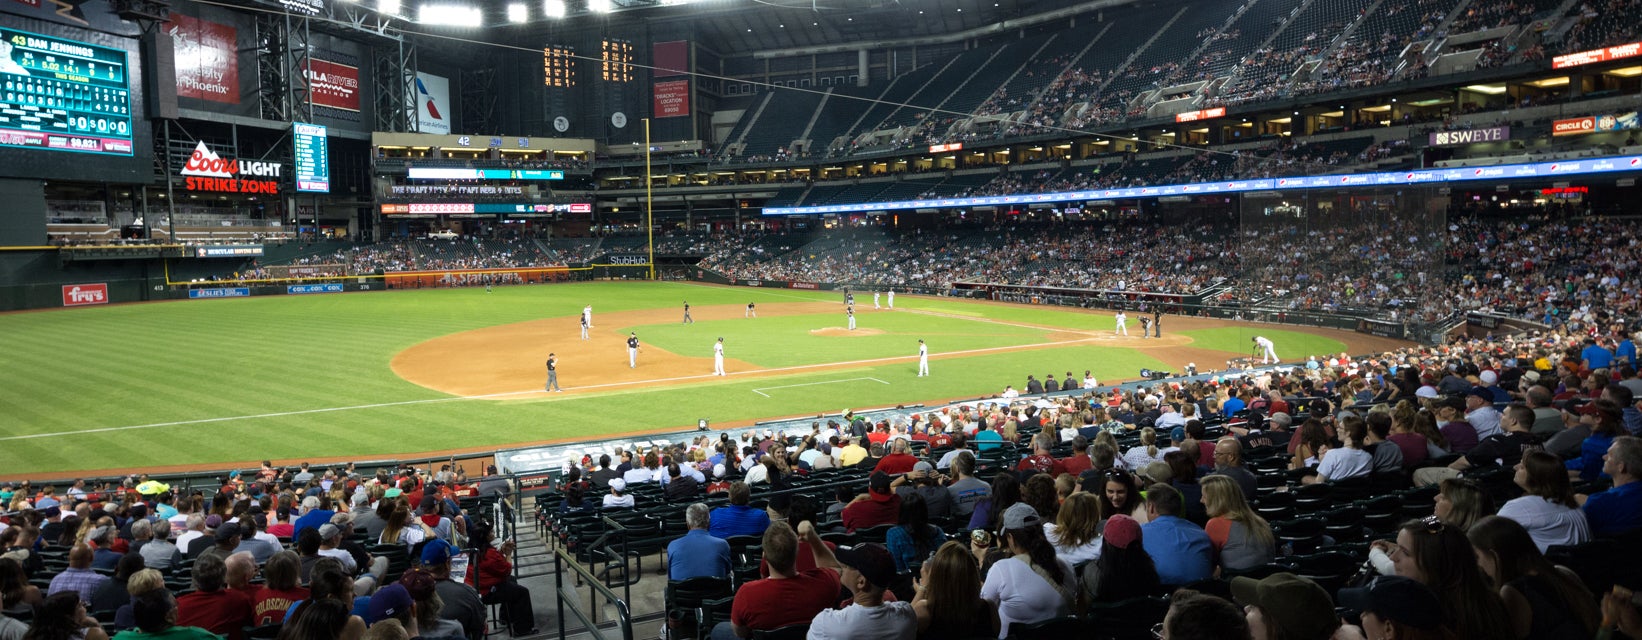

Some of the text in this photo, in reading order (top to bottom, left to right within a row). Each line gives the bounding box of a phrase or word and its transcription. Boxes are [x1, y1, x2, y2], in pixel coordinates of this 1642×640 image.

[12, 35, 94, 58] 43 DAN JENNINGS
[22, 58, 35, 67] 2-1
[64, 64, 79, 74] 14.1
[186, 80, 227, 94] Phoenix
[327, 73, 358, 88] RIVER
[6, 81, 12, 90] 0
[16, 82, 22, 91] 0
[27, 84, 32, 92] 0
[37, 86, 42, 94] 0
[56, 88, 62, 96] 0
[311, 88, 349, 98] CASINOS
[7, 92, 13, 102] 0
[18, 94, 24, 102] 0
[28, 96, 34, 104] 0
[48, 98, 54, 106] 0
[58, 98, 62, 106] 1
[70, 118, 76, 126] B
[78, 116, 87, 129] 0
[90, 120, 96, 128] S
[98, 118, 106, 131] 0
[118, 121, 126, 133] 0
[1556, 122, 1580, 130] CIRCLE
[458, 136, 470, 146] 42
[1450, 128, 1502, 144] SWEYE
[186, 150, 282, 177] Coors LIGHT
[186, 177, 278, 194] STRIKE ZONE
[610, 256, 646, 265] StubHub
[68, 286, 104, 302] fry's
[1249, 438, 1273, 448] OLMSTE
[256, 598, 294, 616] GOLDSCHM
